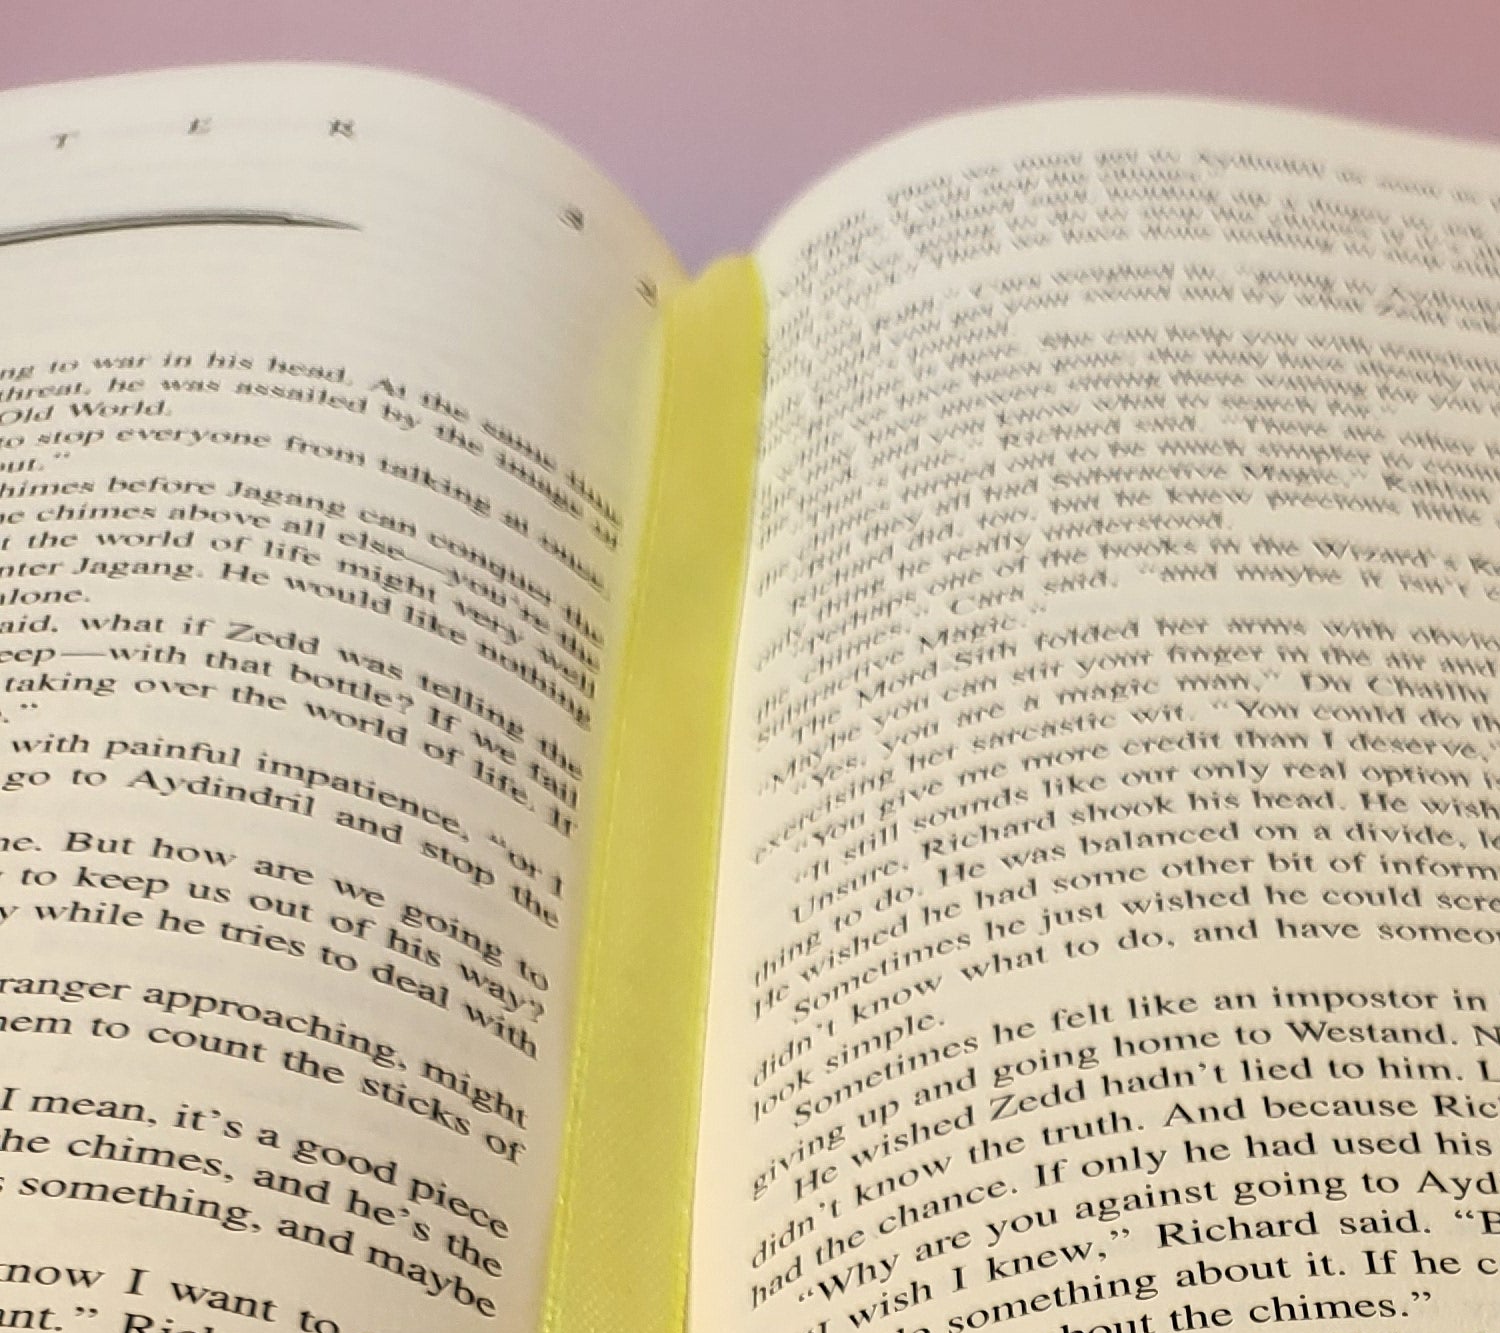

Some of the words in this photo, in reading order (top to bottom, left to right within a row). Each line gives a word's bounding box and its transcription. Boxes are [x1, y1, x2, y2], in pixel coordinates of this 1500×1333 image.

[11, 733, 90, 754] with
[103, 737, 241, 768] painful
[257, 752, 469, 843] impatience,
[551, 875, 563, 899] I
[63, 831, 134, 856] But
[151, 837, 237, 867] how
[253, 859, 315, 886] are
[332, 878, 385, 908] we
[399, 903, 503, 968] going
[515, 958, 549, 991] to
[793, 1036, 979, 1127] Sometimes
[991, 1022, 1036, 1045] he
[1051, 1002, 1115, 1032] felt
[1127, 993, 1199, 1019] like
[1213, 992, 1257, 1011] an
[1271, 985, 1439, 1014] impostor
[1452, 987, 1487, 1012] in
[29, 1095, 157, 1130] mean,
[173, 1103, 243, 1139] it’s
[256, 1128, 281, 1149] a
[291, 1139, 398, 1186] good
[407, 1177, 509, 1239] piece
[67, 1133, 234, 1181] chimes,
[252, 1169, 331, 1205] and
[345, 1188, 431, 1242] he’s
[446, 1233, 502, 1278] the
[17, 1177, 262, 1232] something,
[276, 1219, 355, 1256] and
[365, 1245, 496, 1318] maybe
[1169, 1304, 1234, 1332] the
[1249, 1291, 1432, 1324] chimes.”
[1176, 1257, 1292, 1288] about
[1306, 1251, 1346, 1277] it.
[1361, 1249, 1398, 1276] If
[1411, 1249, 1462, 1275] he
